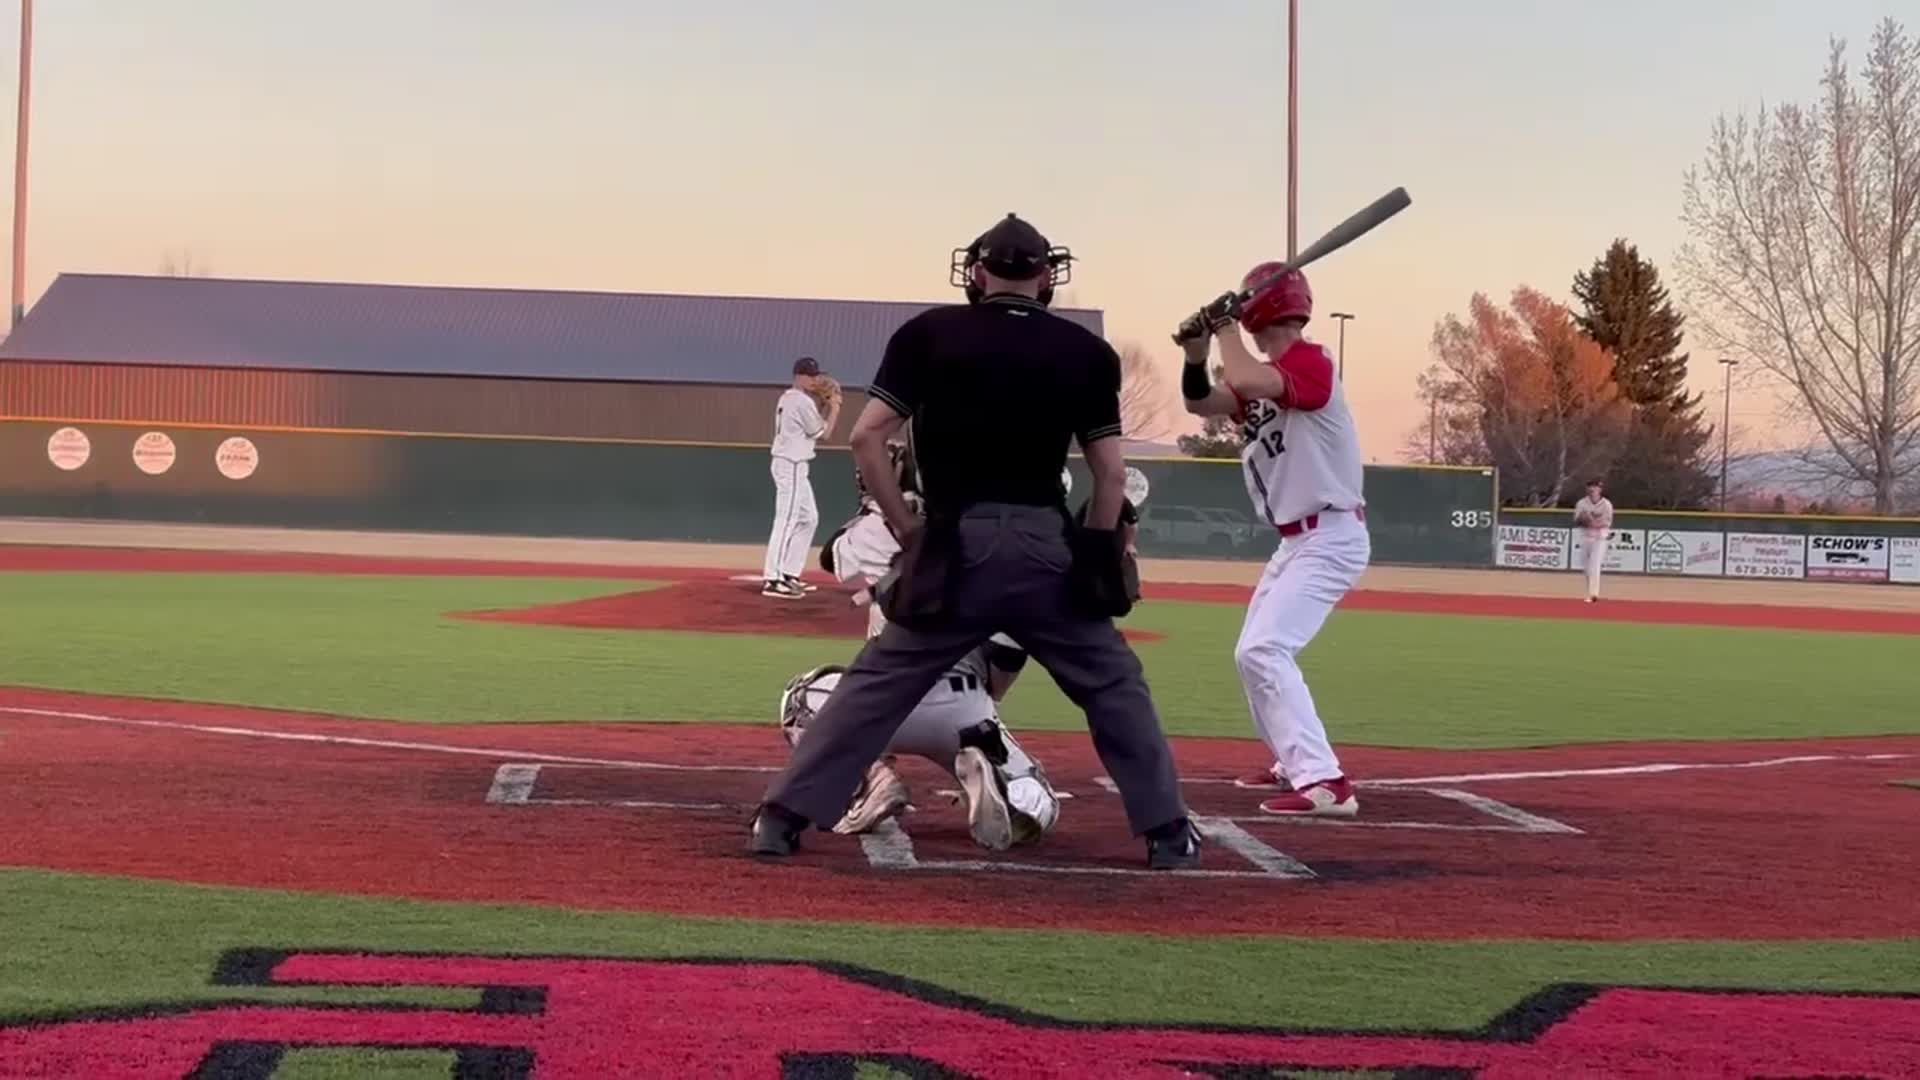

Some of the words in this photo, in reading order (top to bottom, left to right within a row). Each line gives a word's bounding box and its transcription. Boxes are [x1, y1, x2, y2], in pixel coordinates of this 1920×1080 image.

[1260, 430, 1286, 458] 12
[1451, 510, 1492, 528] 385
[1528, 528, 1569, 545] SUPPLY
[1812, 537, 1884, 550] SCHOW'S
